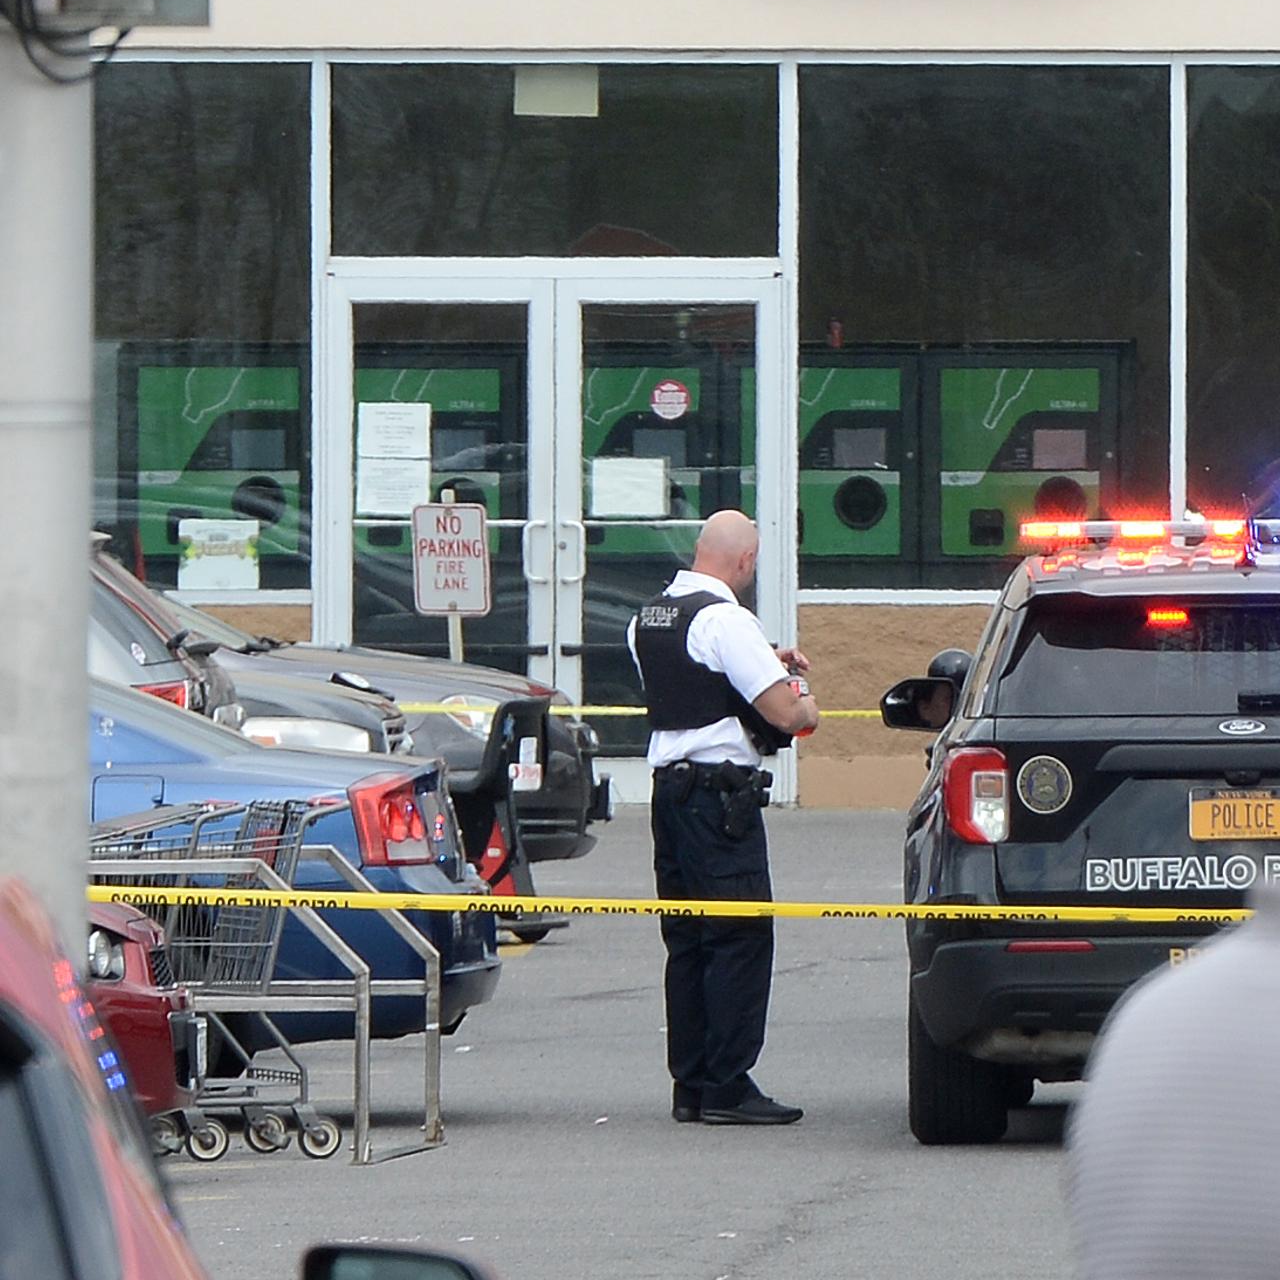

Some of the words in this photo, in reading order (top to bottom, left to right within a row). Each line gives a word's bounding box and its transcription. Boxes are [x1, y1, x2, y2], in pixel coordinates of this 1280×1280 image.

[436, 515, 461, 535] NO
[420, 538, 482, 558] PARKING
[436, 560, 466, 575] FIRE
[434, 577, 469, 591] LANE
[1211, 803, 1275, 829] POLICE
[1086, 855, 1256, 891] BUFFALO
